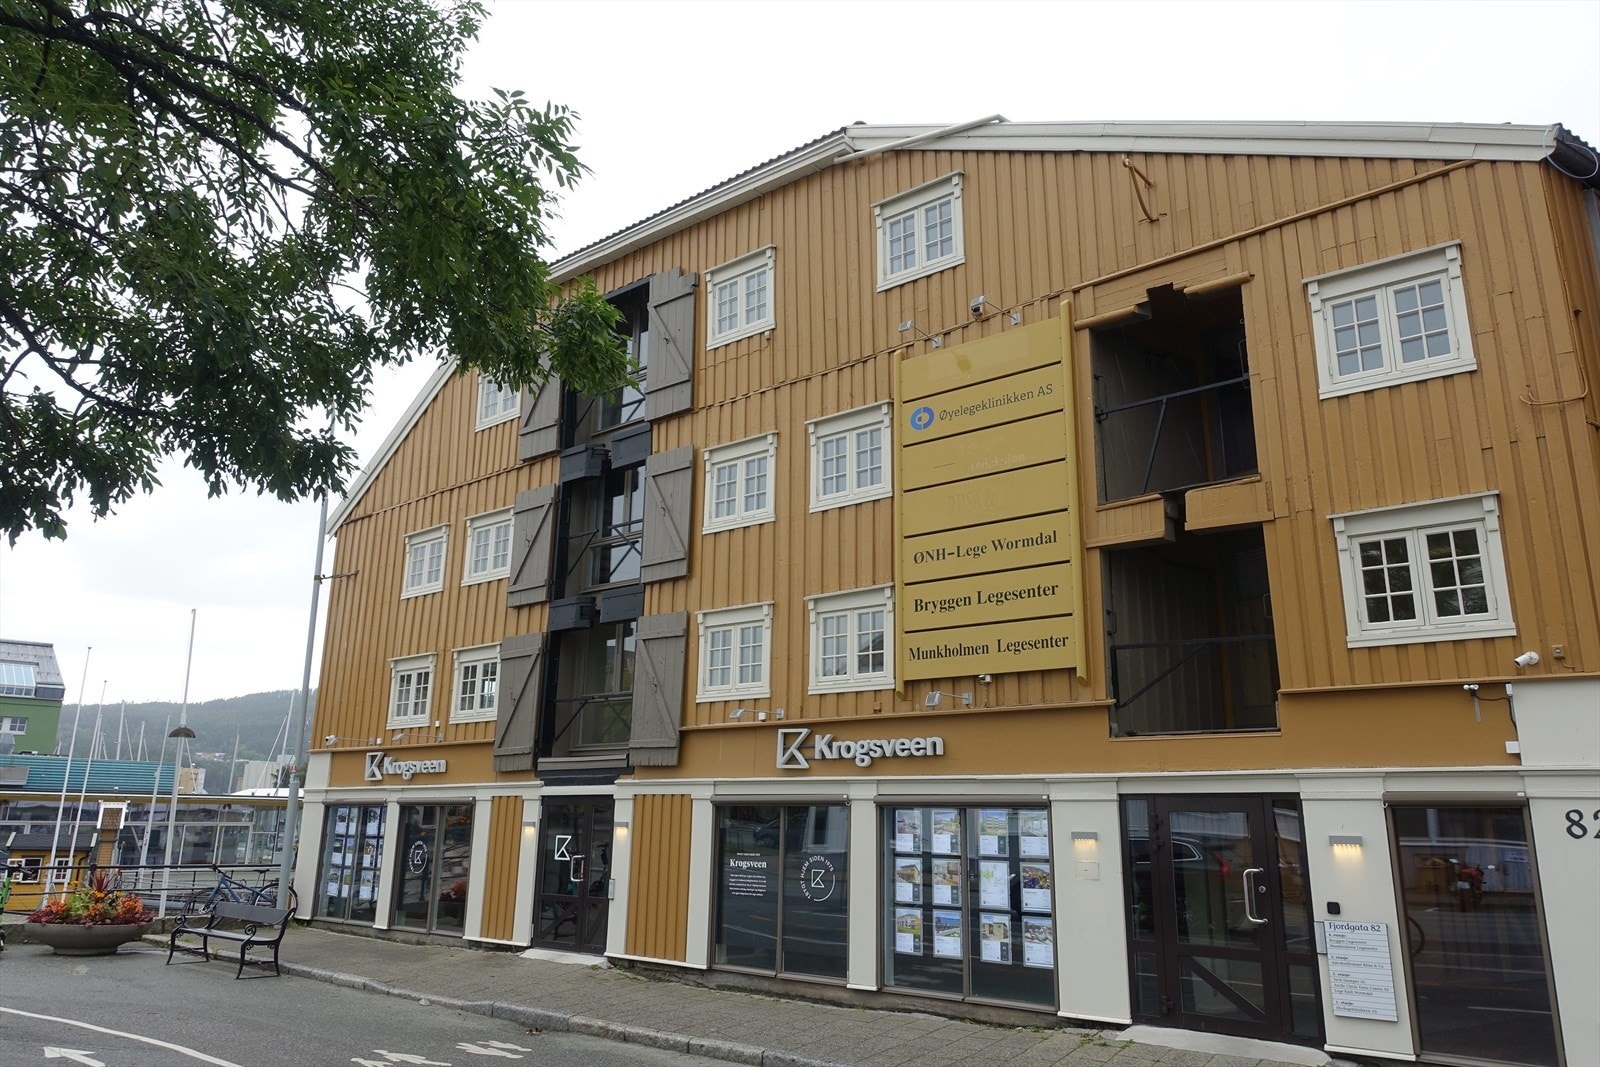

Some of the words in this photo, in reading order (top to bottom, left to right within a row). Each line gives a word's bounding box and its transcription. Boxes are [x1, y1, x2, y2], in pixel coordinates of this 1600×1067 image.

[939, 390, 1034, 421] Øyelegeklinikken
[1037, 383, 1053, 398] AS
[913, 544, 988, 565] ØNH-Lege
[991, 530, 1058, 552] Wormdal
[914, 594, 972, 614] Bryggen
[976, 584, 1059, 606] Legesenter
[909, 642, 989, 662] Munkholmen
[997, 635, 1069, 656] Legesenter
[814, 733, 944, 768] Krogsveen
[383, 756, 447, 780] Krogsveen
[730, 858, 767, 869] Krogsveen
[1328, 922, 1369, 932] Fjordgata
[1371, 924, 1381, 932] 82
